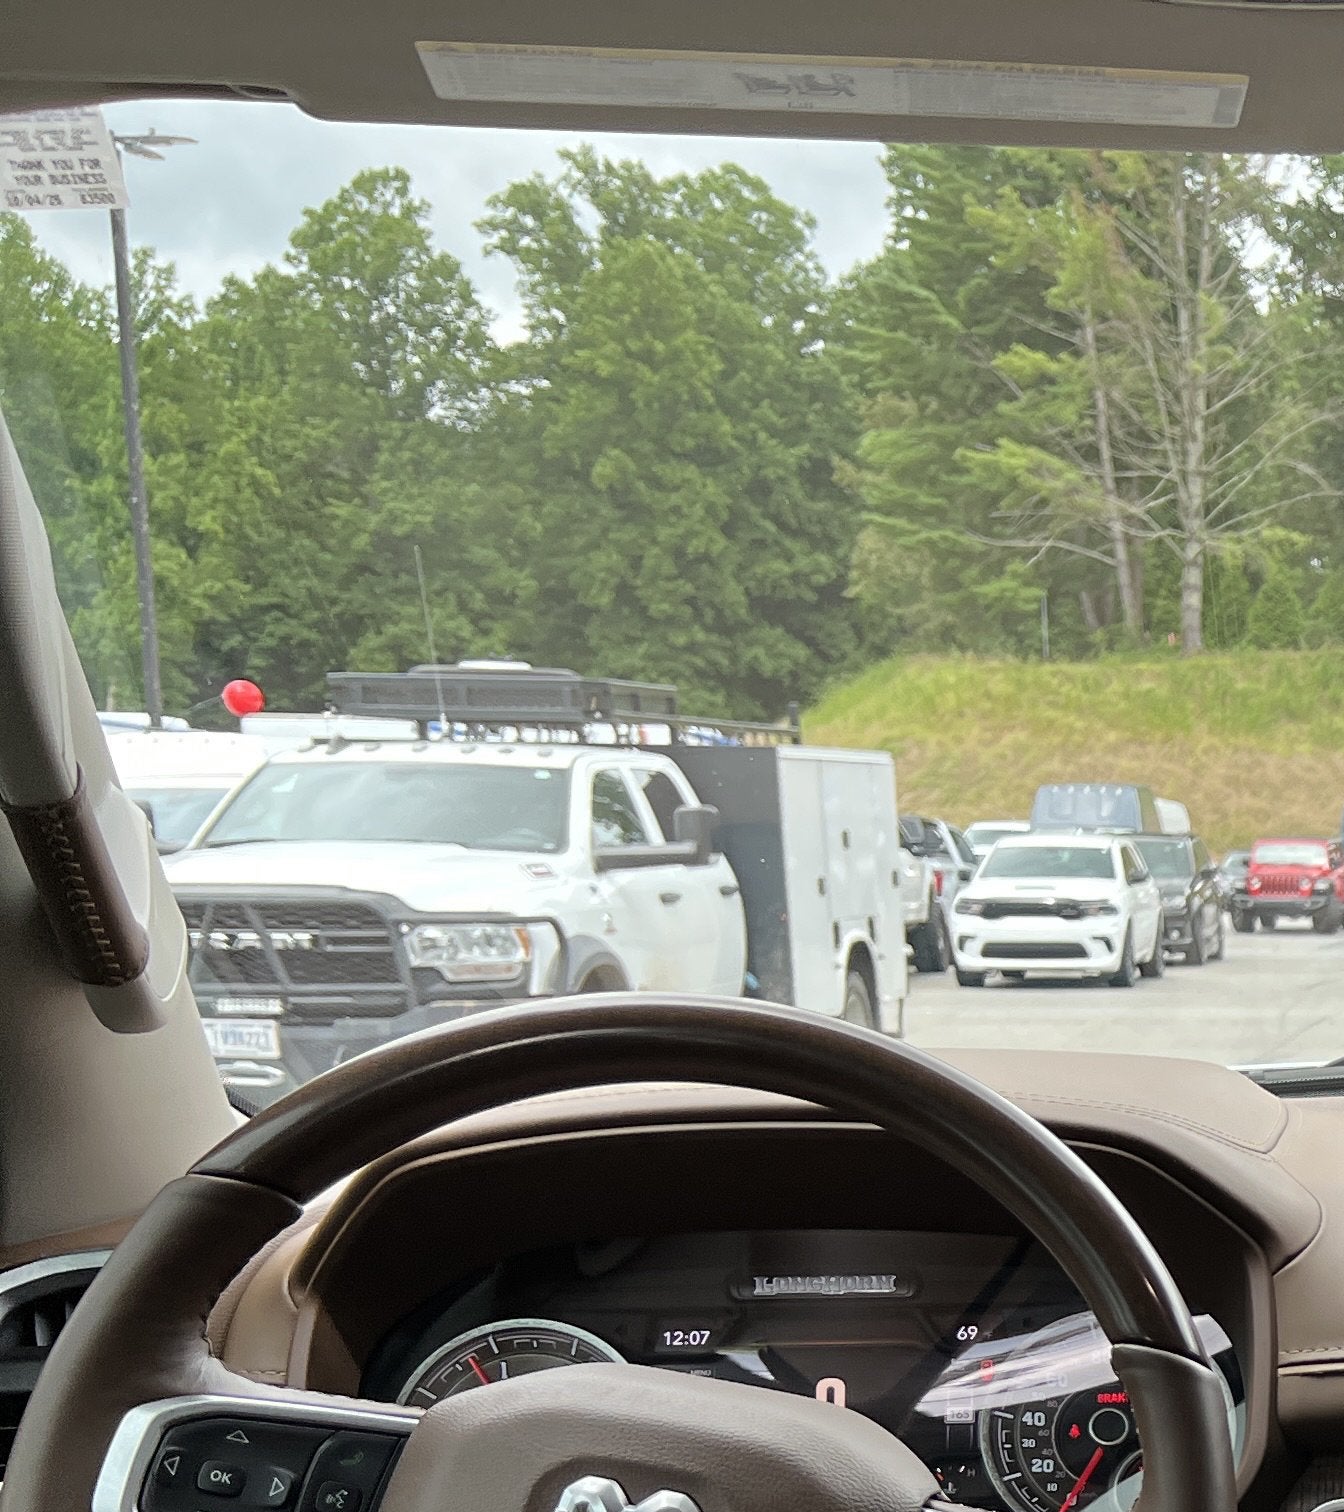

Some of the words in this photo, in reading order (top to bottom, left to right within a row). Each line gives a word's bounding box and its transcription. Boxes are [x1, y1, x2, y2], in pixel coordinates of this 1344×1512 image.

[79, 159, 102, 170] FOR
[48, 173, 107, 184] BUSINESS
[753, 1275, 897, 1296] LONGHORN
[663, 1330, 711, 1347] 12:07
[956, 1325, 978, 1341] 69
[1097, 1391, 1129, 1405] BRAK
[1021, 1411, 1047, 1428] 40
[1021, 1438, 1037, 1449] 30
[1031, 1459, 1055, 1474] 20
[210, 1470, 233, 1485] OK
[1047, 1482, 1059, 1493] 10
